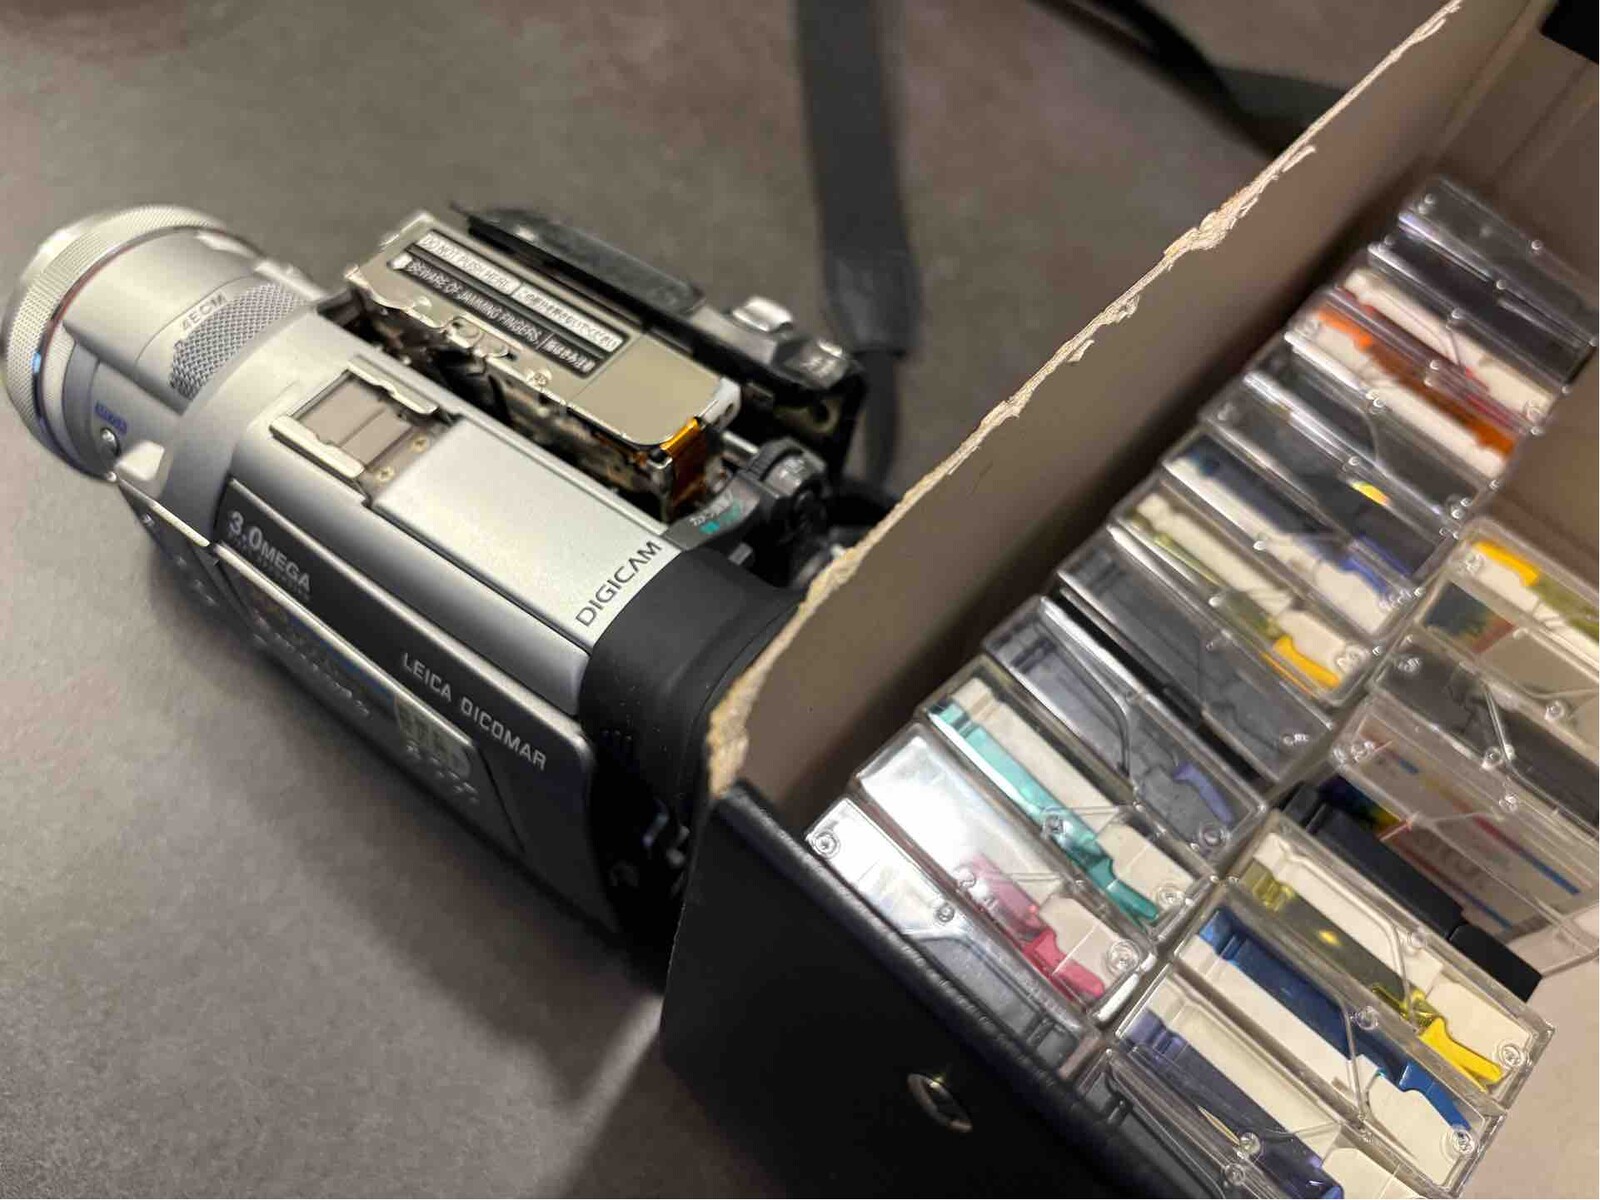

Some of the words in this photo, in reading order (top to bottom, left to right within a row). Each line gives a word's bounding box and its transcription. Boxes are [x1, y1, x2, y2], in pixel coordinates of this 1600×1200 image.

[445, 282, 463, 298] OF
[575, 541, 663, 627] DIGICAM
[402, 652, 452, 702] LEICA
[459, 698, 546, 771] DICOMAR
